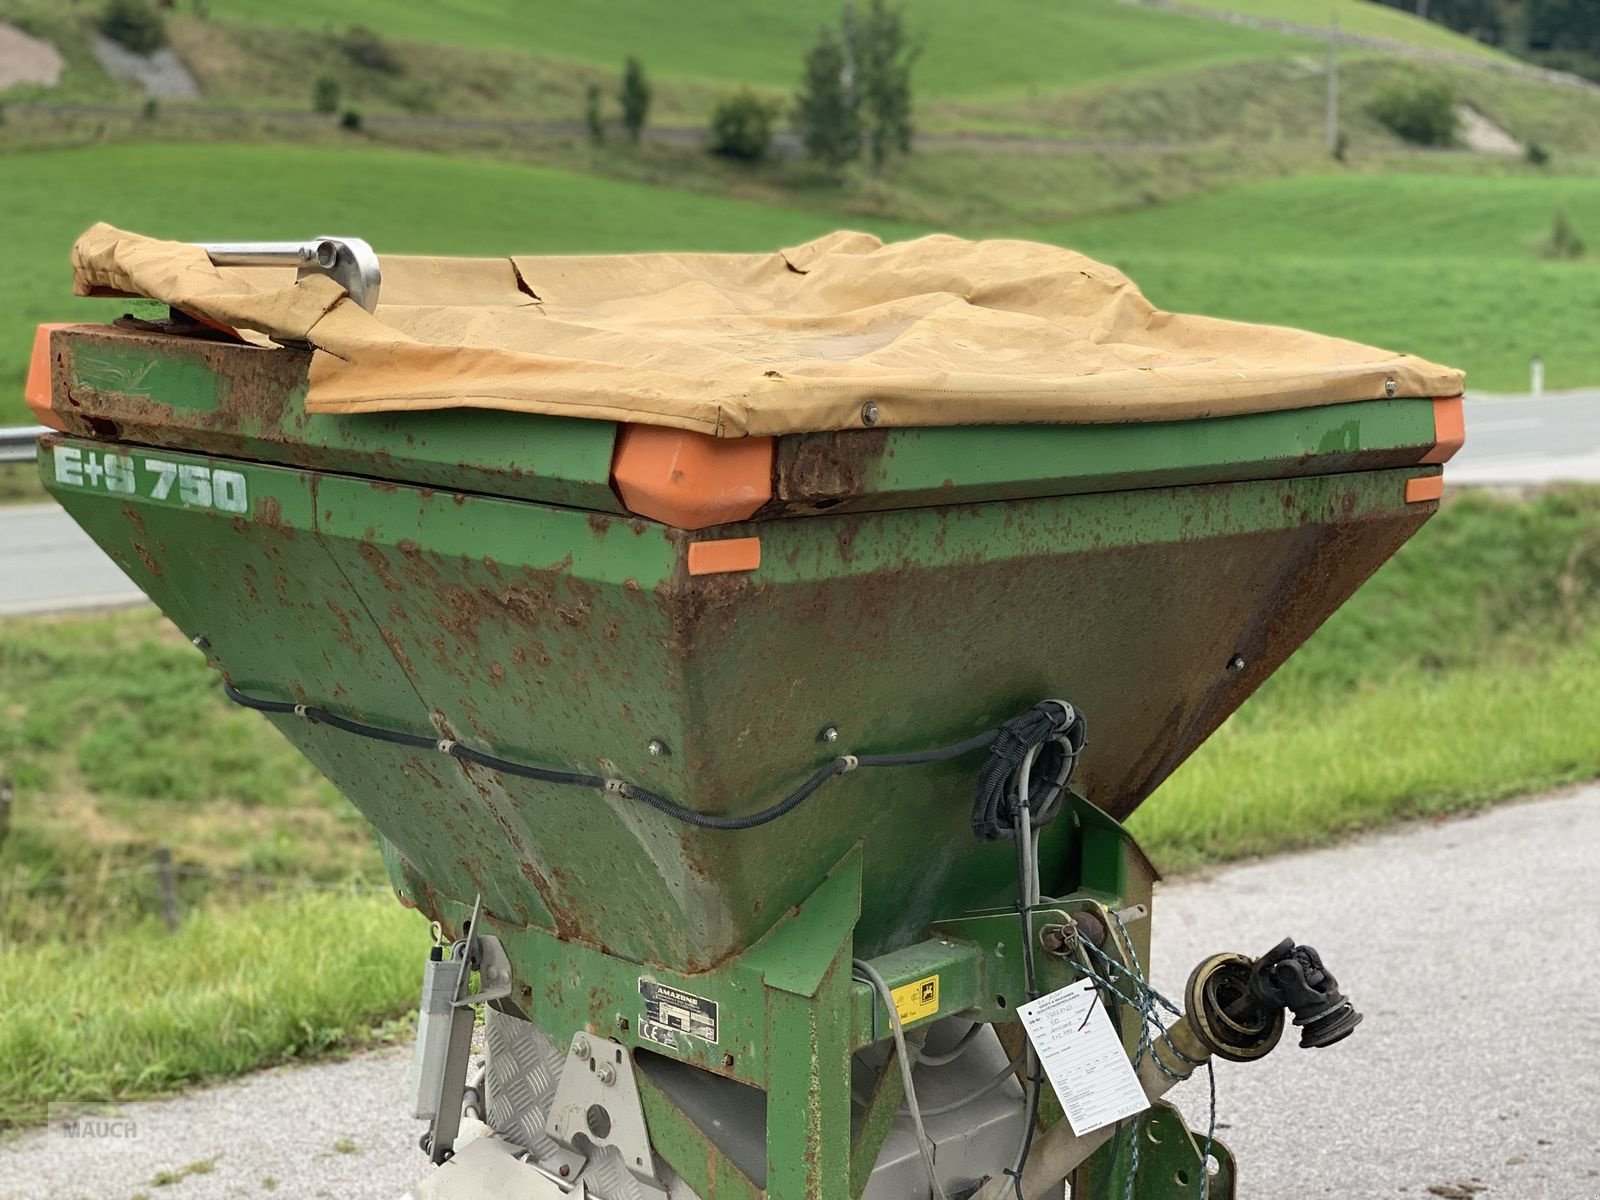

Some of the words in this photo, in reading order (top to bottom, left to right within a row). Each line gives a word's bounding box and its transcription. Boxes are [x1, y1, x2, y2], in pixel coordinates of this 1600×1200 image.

[54, 445, 136, 494] E+S
[145, 459, 248, 514] 750
[657, 987, 698, 1005] AMAZONE
